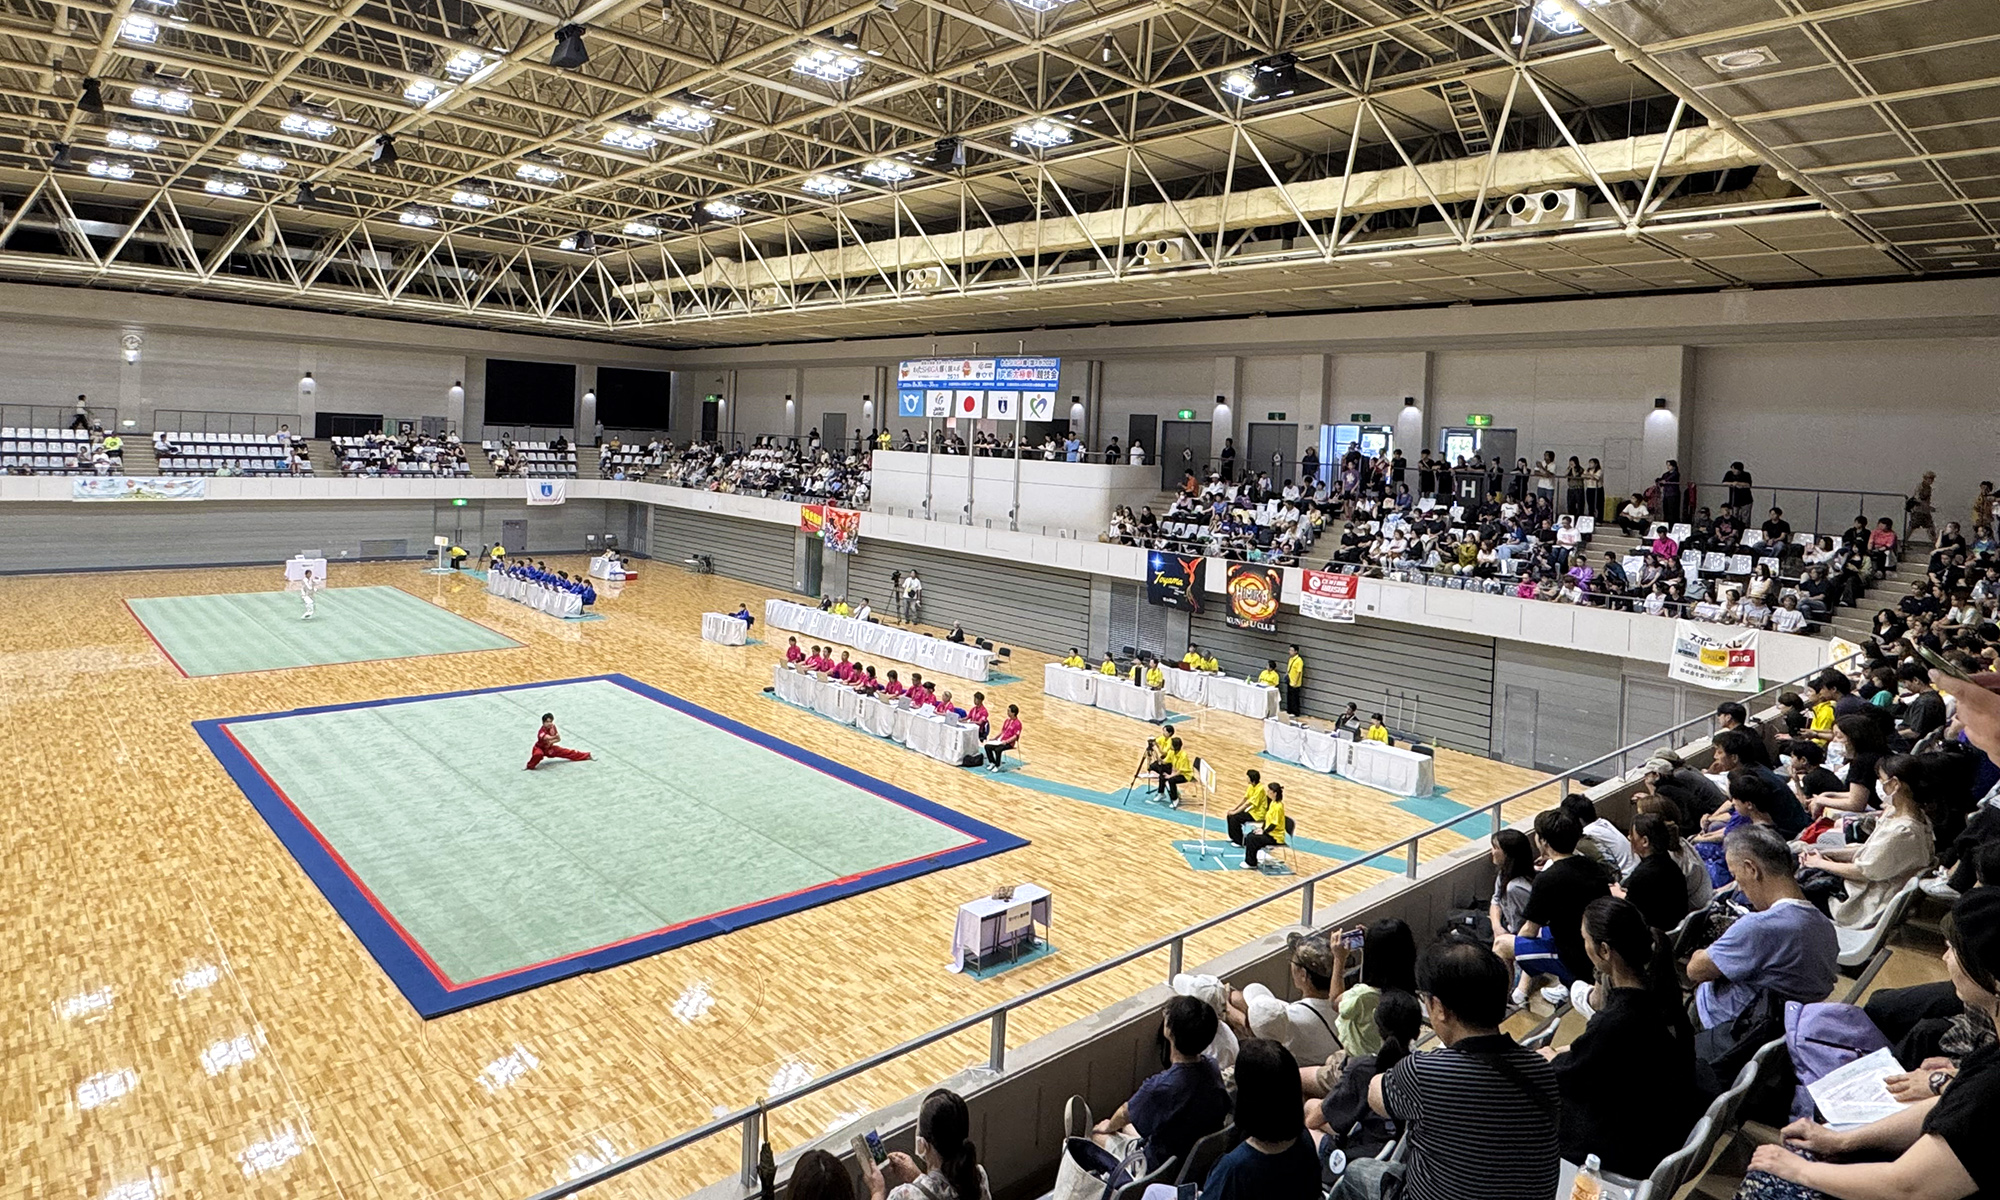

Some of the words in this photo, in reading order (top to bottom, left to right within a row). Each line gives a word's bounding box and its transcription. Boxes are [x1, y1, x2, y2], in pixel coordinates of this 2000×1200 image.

[1460, 479, 1476, 498] H
[1153, 570, 1184, 587] Toyama
[1690, 632, 1742, 649] スポーツくじ
[1732, 655, 1751, 663] BIG
